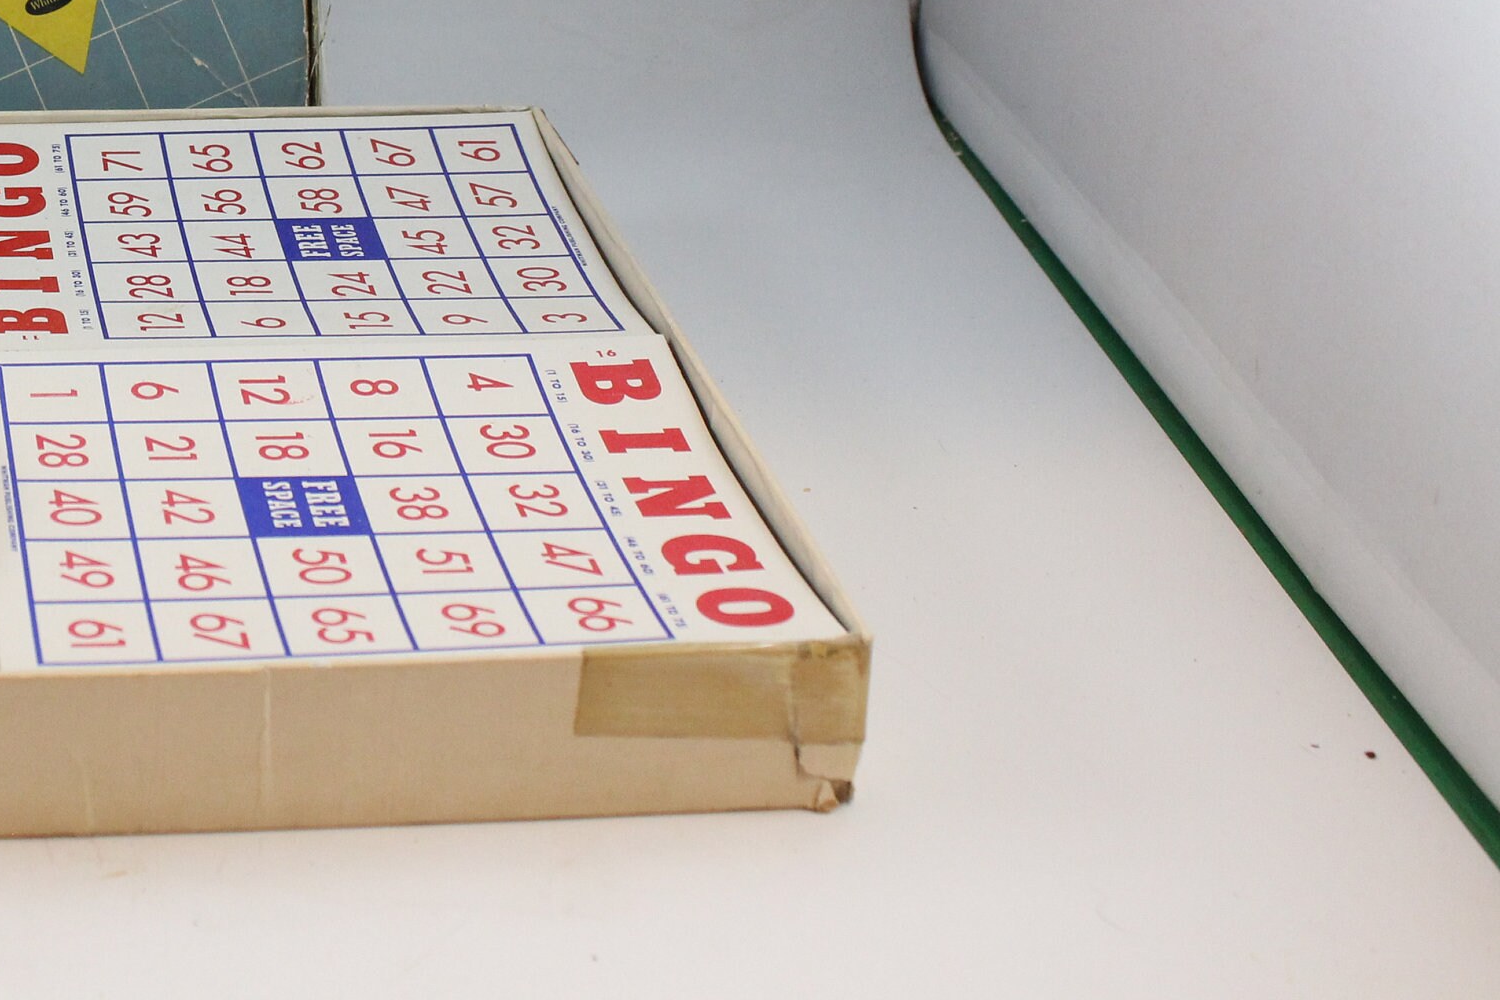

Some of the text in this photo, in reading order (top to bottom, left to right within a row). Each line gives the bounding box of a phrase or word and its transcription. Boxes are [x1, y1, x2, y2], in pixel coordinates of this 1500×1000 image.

[101, 151, 185, 331] 12 28 43 59 71
[189, 143, 287, 329] 6 18 44 56 65
[280, 141, 390, 329] 15 24 58 62
[291, 224, 332, 258] FREE
[330, 224, 365, 257] SPACE
[371, 139, 485, 325] 9 22 45 47 67
[458, 139, 501, 163] 61
[469, 182, 518, 208] 57
[491, 225, 541, 249] 32
[516, 267, 568, 292] 30
[541, 313, 588, 323] 3
[30, 389, 127, 649] 1 28 40 49 61
[131, 382, 252, 650] 6 21 42 46 67
[239, 376, 377, 645] 12 18 50 65
[262, 481, 303, 529] SPACE
[301, 480, 350, 528] FREE
[350, 379, 507, 638] 8 16 38 51 69
[468, 373, 632, 633] 4 30 32 47 66
[569, 358, 797, 629] BINGO
